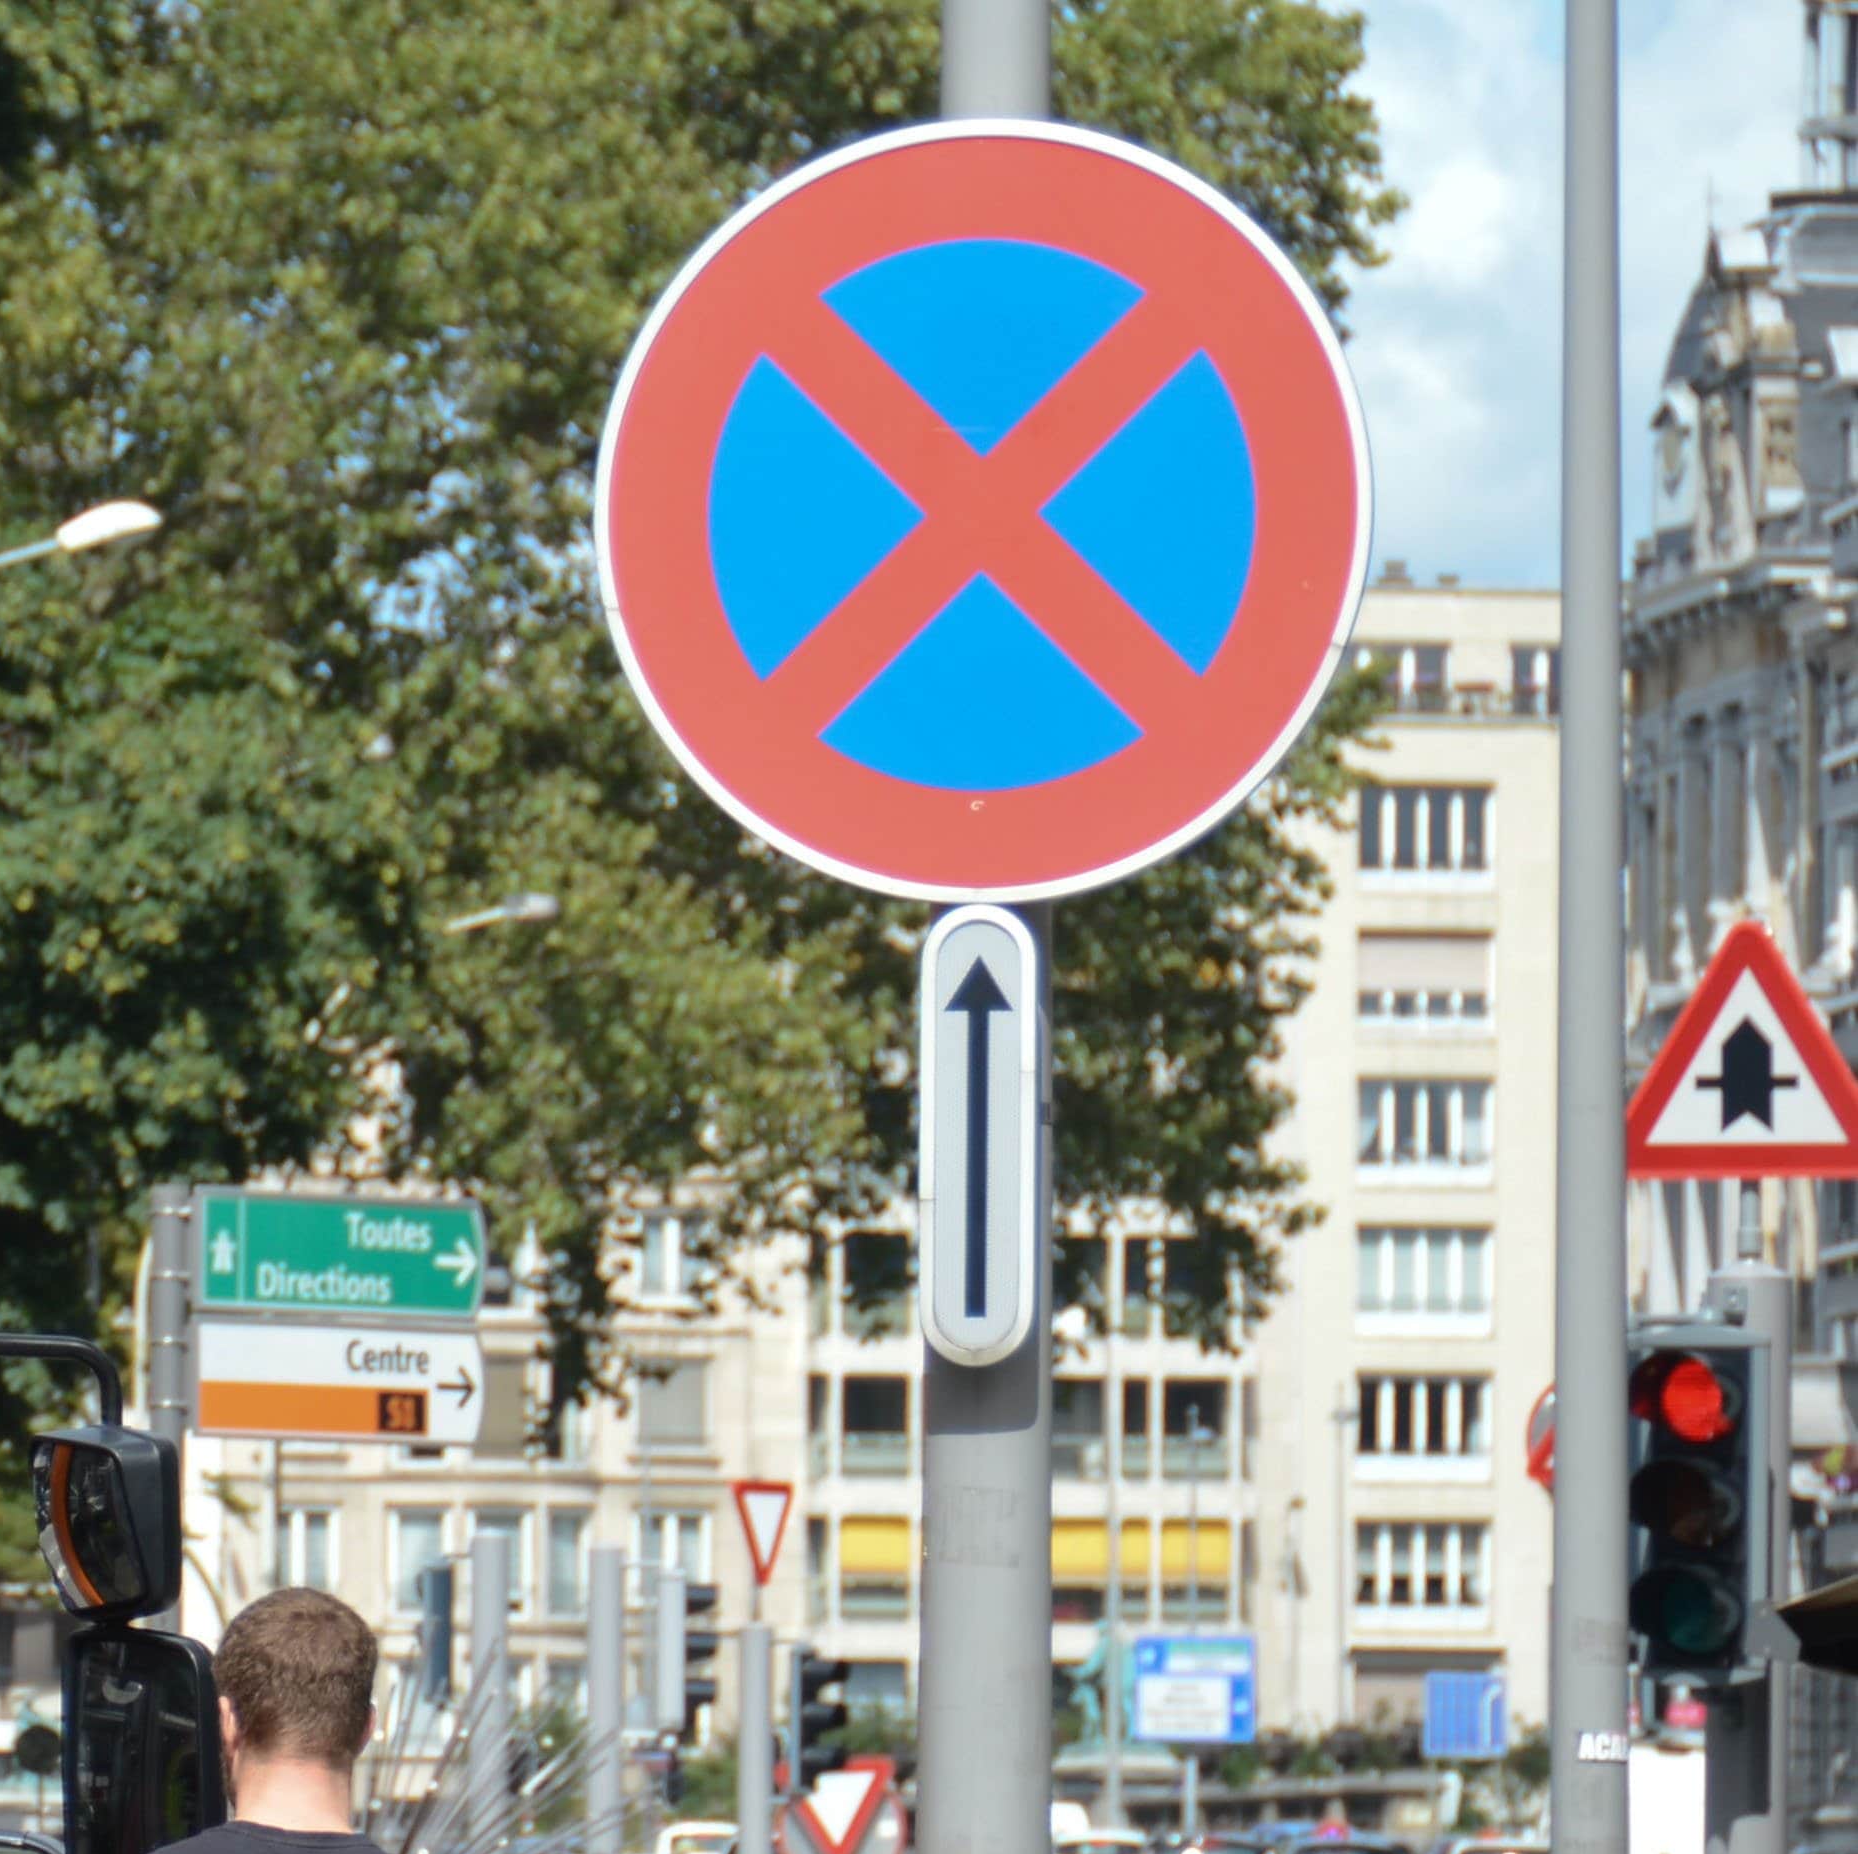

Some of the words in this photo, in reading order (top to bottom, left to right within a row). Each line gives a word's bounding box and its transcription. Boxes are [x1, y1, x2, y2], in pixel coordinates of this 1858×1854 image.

[344, 1210, 432, 1253] Toutes
[256, 1261, 393, 1305] Directions
[346, 1339, 431, 1375] Centre
